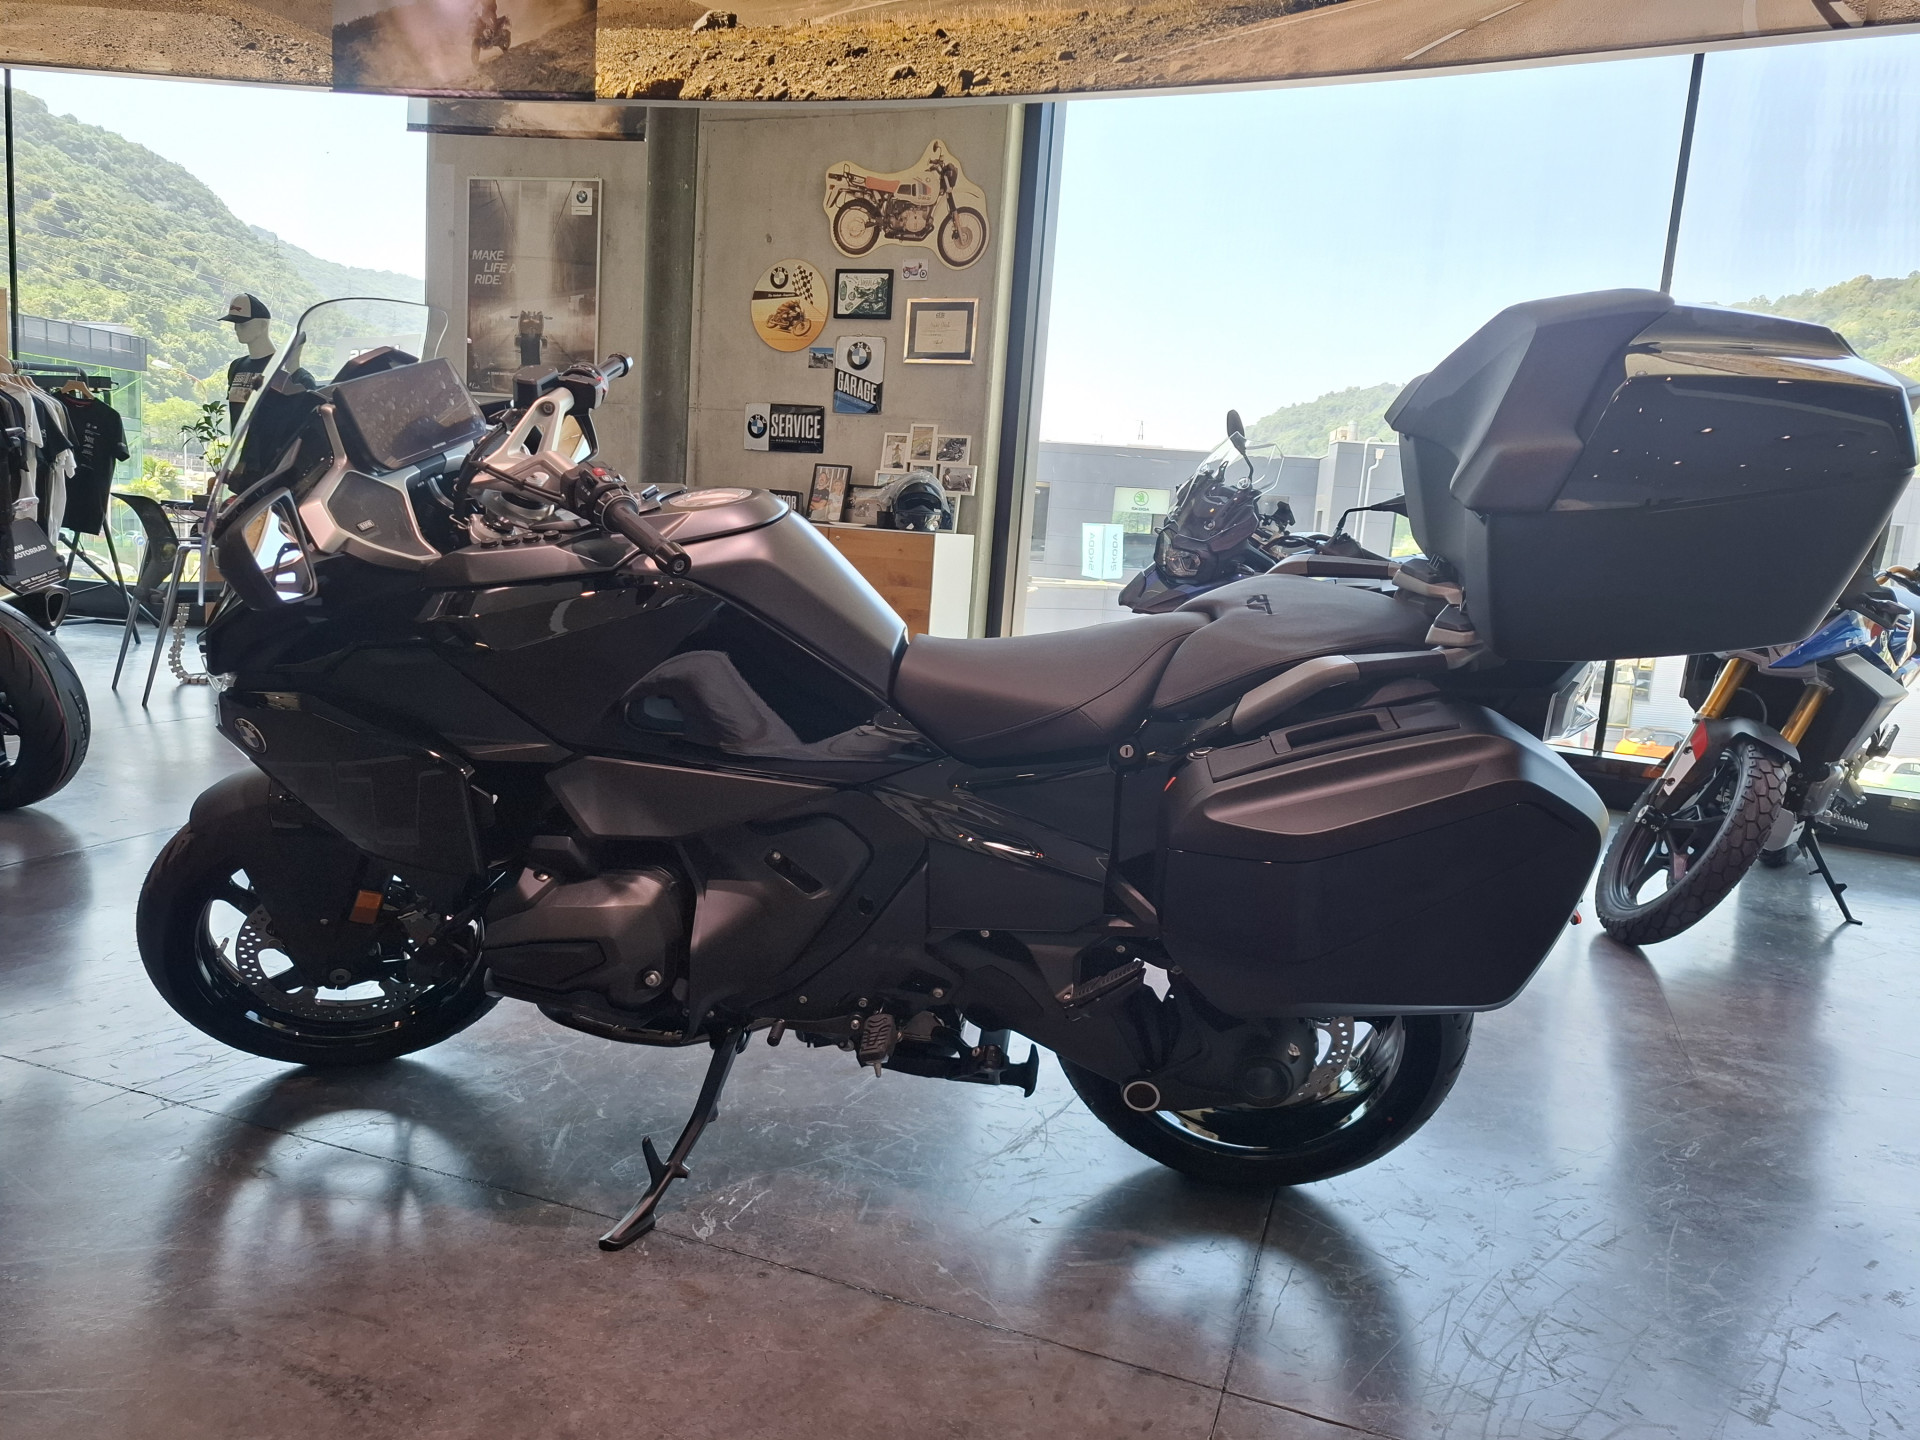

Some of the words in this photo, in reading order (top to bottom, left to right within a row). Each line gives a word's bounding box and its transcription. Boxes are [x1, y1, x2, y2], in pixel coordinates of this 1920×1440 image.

[472, 249, 505, 261] MAKE
[484, 262, 508, 273] LIFE
[508, 263, 517, 274] A
[474, 274, 502, 285] RIDE.
[837, 371, 877, 404] GARAGE
[770, 413, 821, 438] SERVICE
